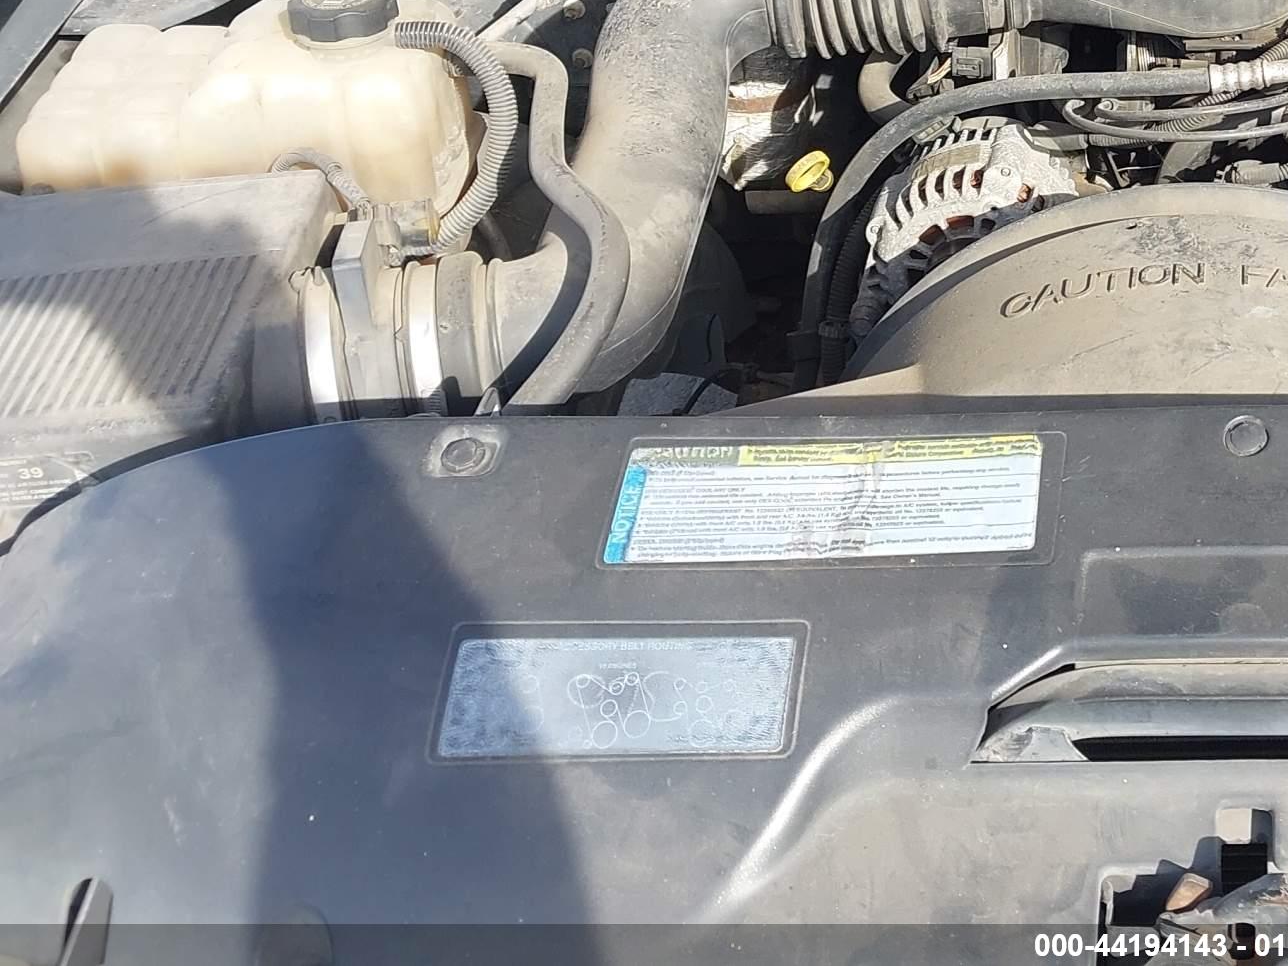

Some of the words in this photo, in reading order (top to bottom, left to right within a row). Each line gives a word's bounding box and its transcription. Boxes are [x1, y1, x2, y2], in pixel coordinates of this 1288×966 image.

[1000, 261, 1206, 319] CAUTION
[17, 466, 44, 480] 39
[611, 486, 643, 544] NOTICE
[620, 641, 645, 651] BELT
